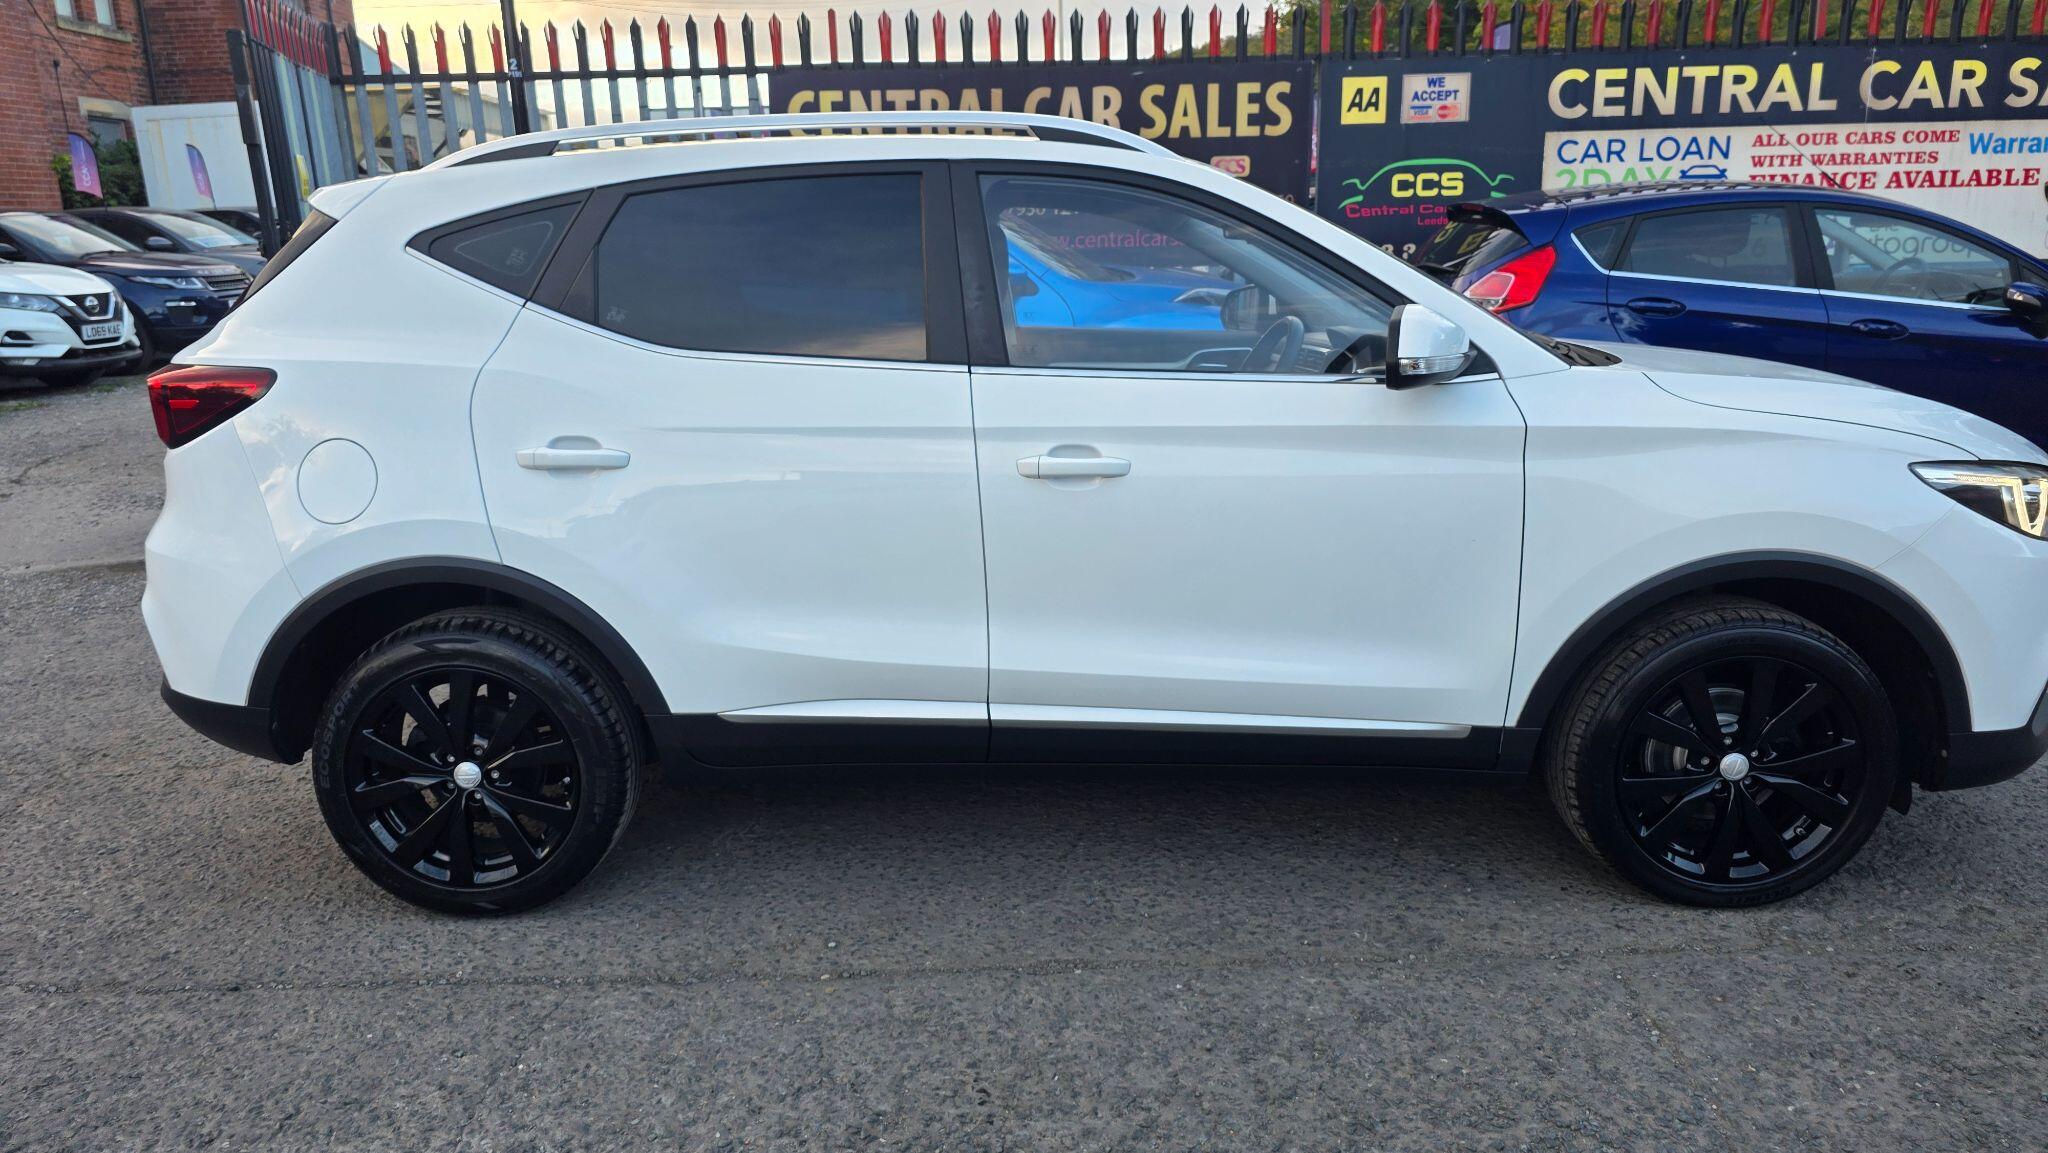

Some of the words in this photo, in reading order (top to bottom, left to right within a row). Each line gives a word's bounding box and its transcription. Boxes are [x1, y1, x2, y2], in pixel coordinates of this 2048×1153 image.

[1427, 76, 1446, 89] WE
[1548, 62, 1837, 119] CENTRAL
[1859, 60, 1985, 110] CAR
[2004, 57, 2048, 108] S
[1347, 87, 1380, 113] AA
[1412, 90, 1459, 102] ACCEPT
[788, 88, 1015, 137] CENTRAL
[1024, 85, 1123, 131] CAR
[1139, 81, 1293, 139] SALES
[1752, 134, 1789, 147] ALL
[1796, 132, 1839, 146] OUR
[1845, 131, 1896, 144] CARS
[1902, 130, 1961, 143] COME
[1557, 138, 1626, 164] CAR
[1638, 135, 1731, 162] LOAN
[1751, 154, 1803, 168] WITH
[1810, 151, 1939, 166] WARRANTIES
[1391, 172, 1464, 198] CCS
[1885, 168, 2041, 190] AVAILABLE
[1345, 204, 1414, 218] Central
[1418, 216, 1449, 226] Leeds
